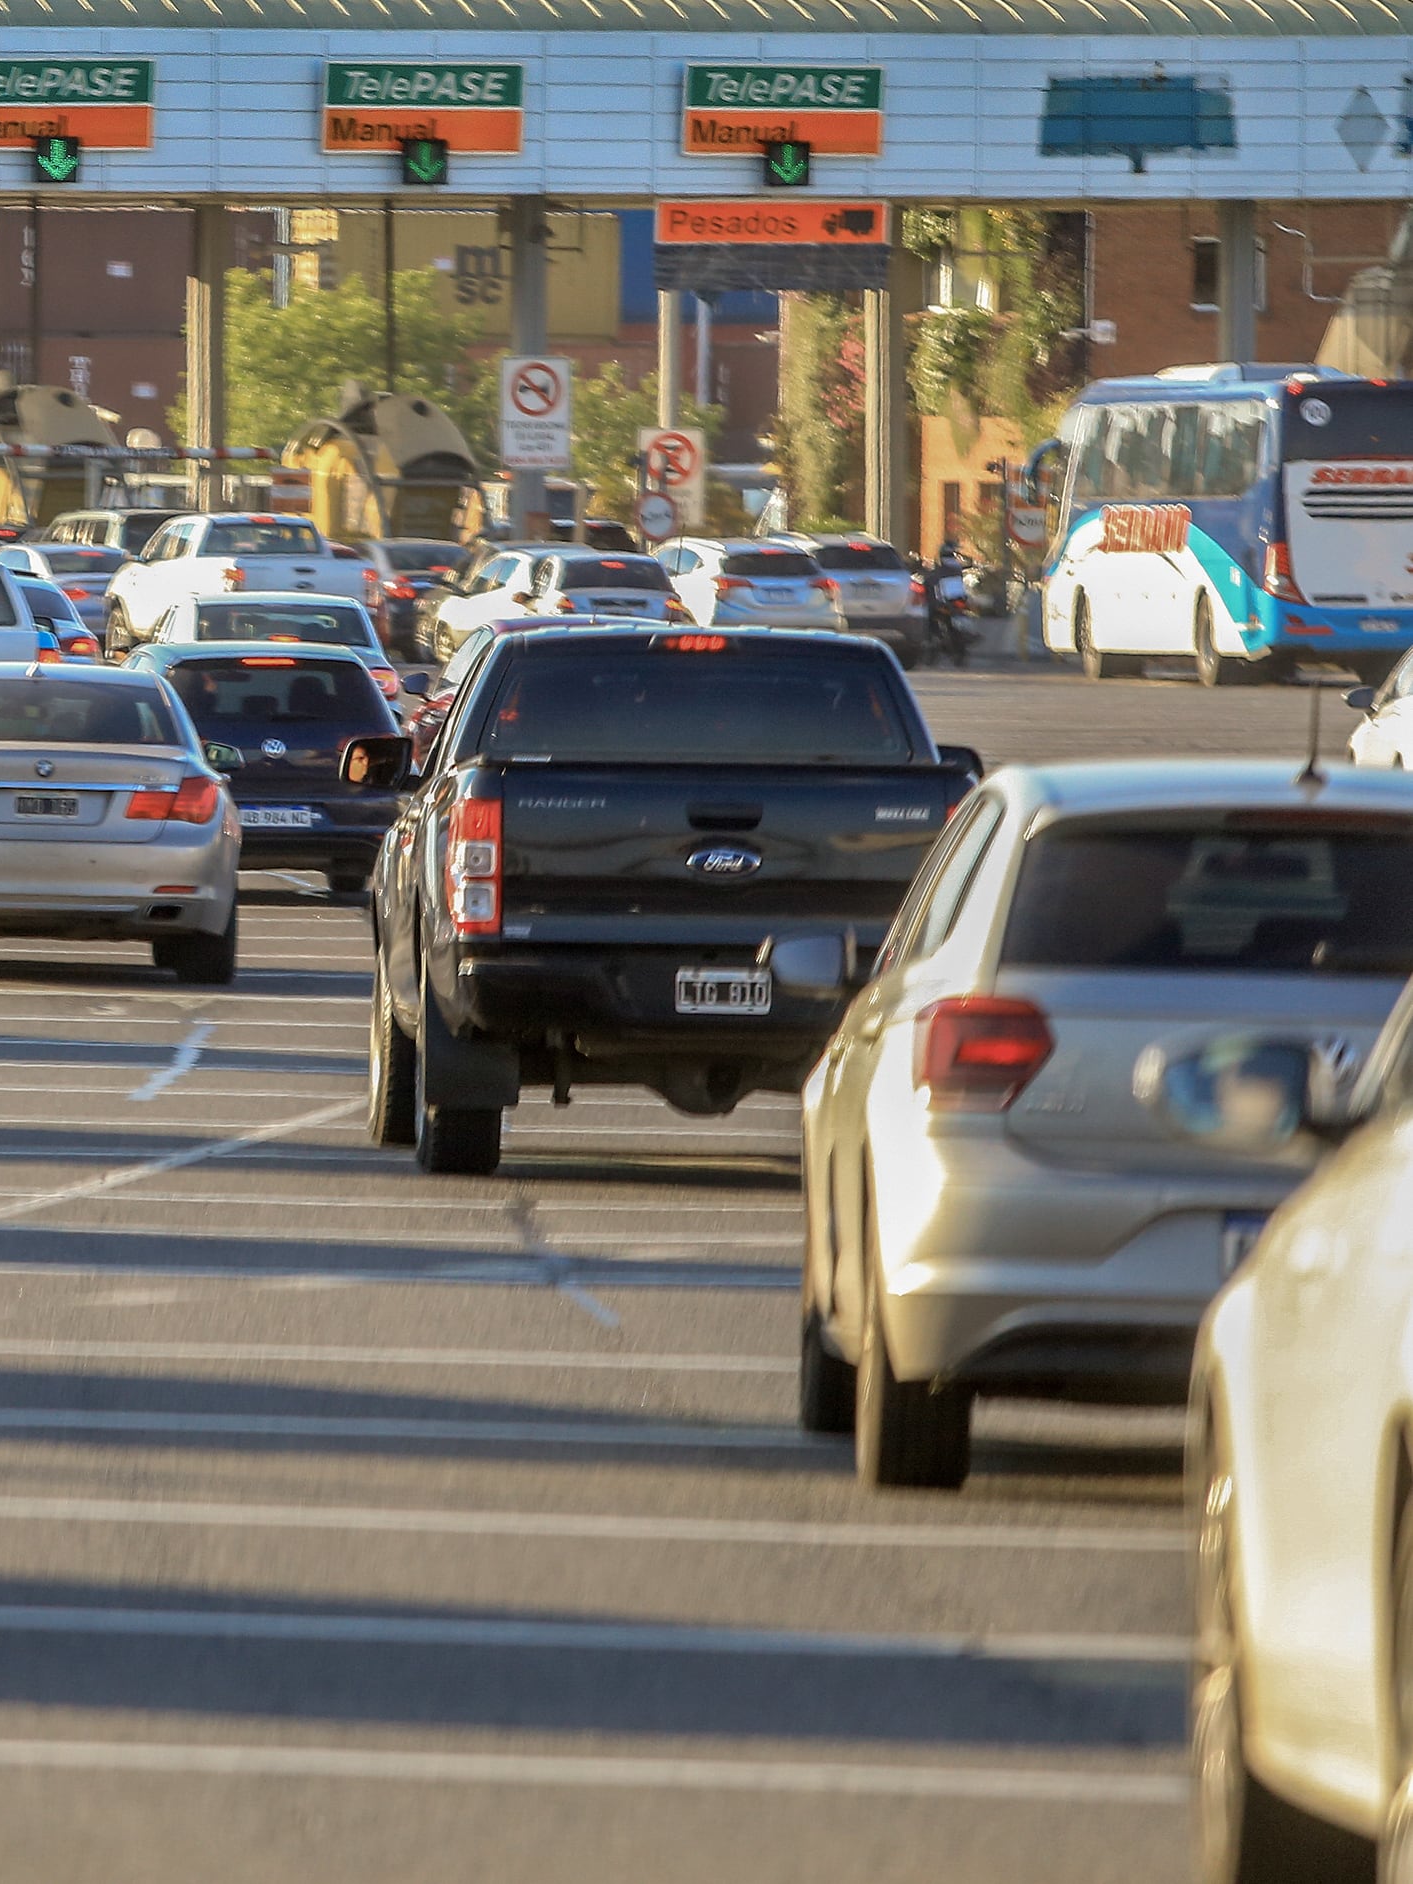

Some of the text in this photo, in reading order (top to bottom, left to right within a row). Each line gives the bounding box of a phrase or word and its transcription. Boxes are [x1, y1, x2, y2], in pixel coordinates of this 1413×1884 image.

[343, 70, 508, 102] TelePASE
[705, 71, 866, 104] TelePASE
[331, 117, 436, 140] Manual
[691, 119, 797, 143] Manual
[669, 209, 798, 235] Pesados
